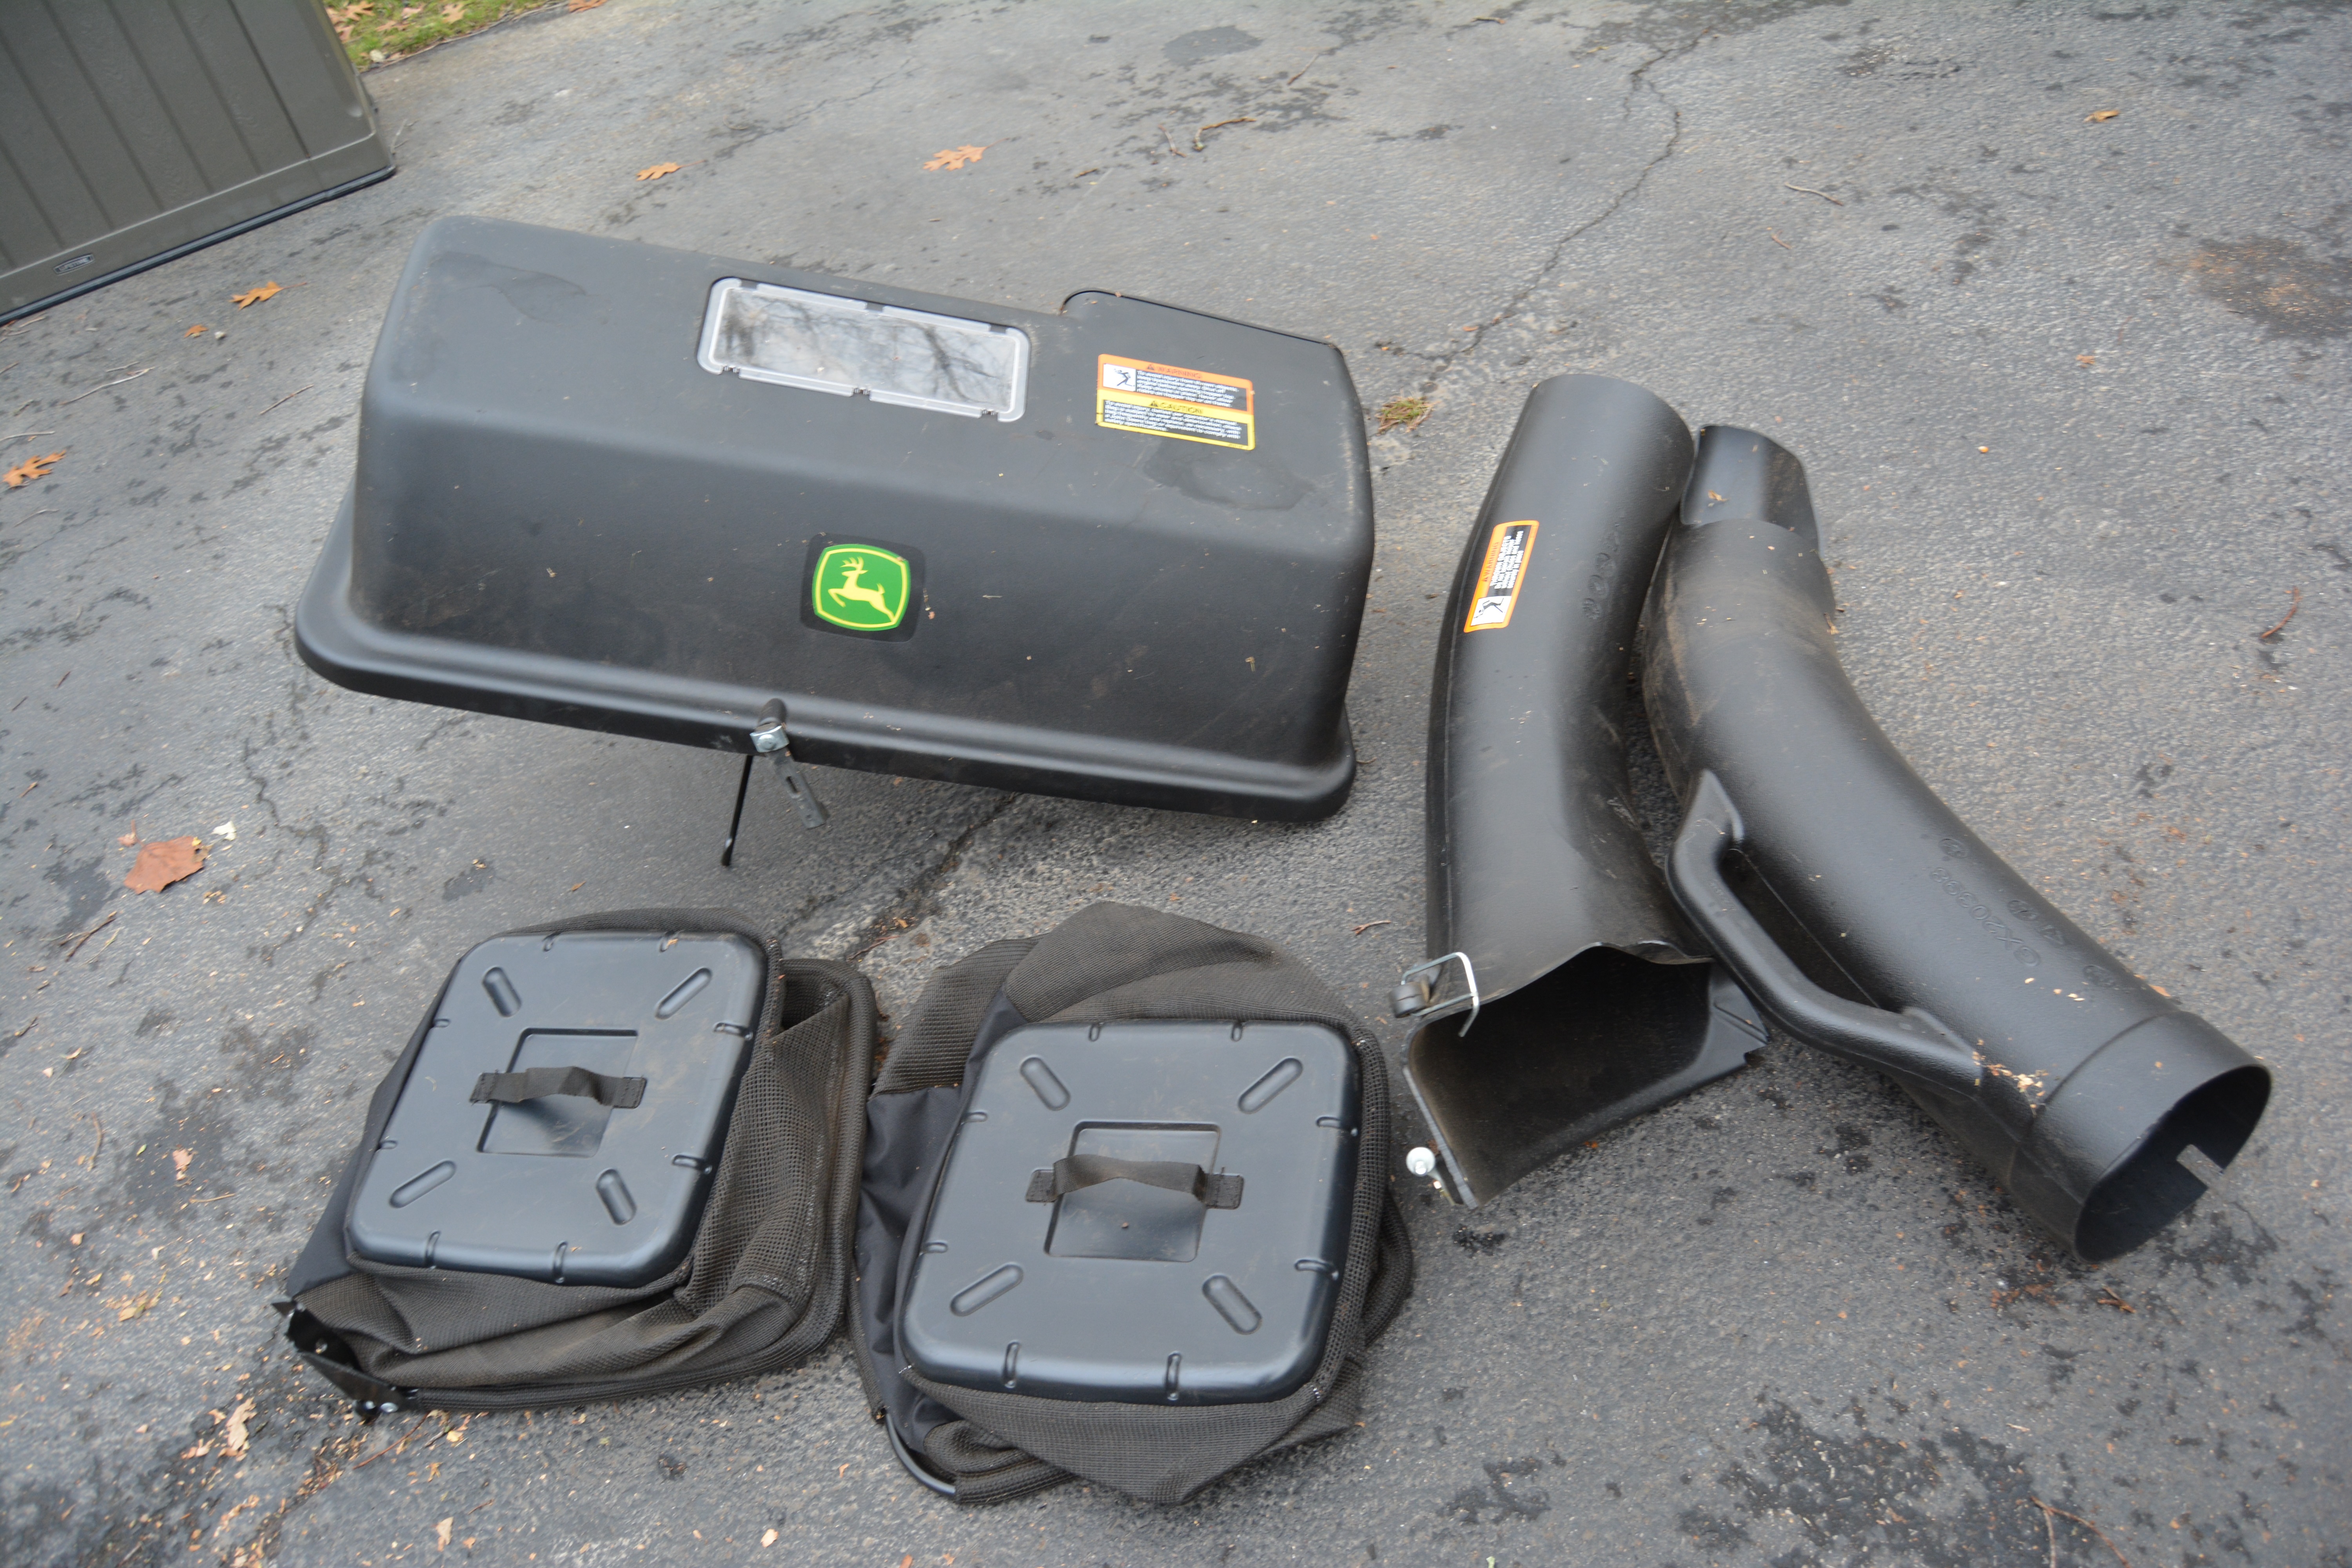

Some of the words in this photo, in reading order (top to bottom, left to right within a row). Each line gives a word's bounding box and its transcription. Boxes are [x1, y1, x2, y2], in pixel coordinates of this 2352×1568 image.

[1157, 365, 1201, 378] WARNING
[1152, 377, 1185, 387] bystanders
[1177, 386, 1202, 395] opening
[1125, 408, 1147, 416] subject
[1160, 401, 1202, 415] CAUTION
[1118, 411, 1149, 421] frequently
[1183, 414, 1214, 423] operator's
[1165, 423, 1196, 433] equivalent
[1514, 530, 1524, 545] hoses
[1505, 539, 1515, 555] mower
[1510, 545, 1519, 555] and
[1484, 541, 1500, 576] WARNING
[1489, 561, 1504, 586] THROWN
[1497, 535, 1511, 561] OBJECTS
[1499, 555, 1511, 573] operate
[1506, 555, 1517, 571] chutes
[1496, 573, 1505, 581] not
[1501, 571, 1512, 588] without
[1506, 568, 1519, 588] securely
[1929, 867, 2040, 967] GX20398
